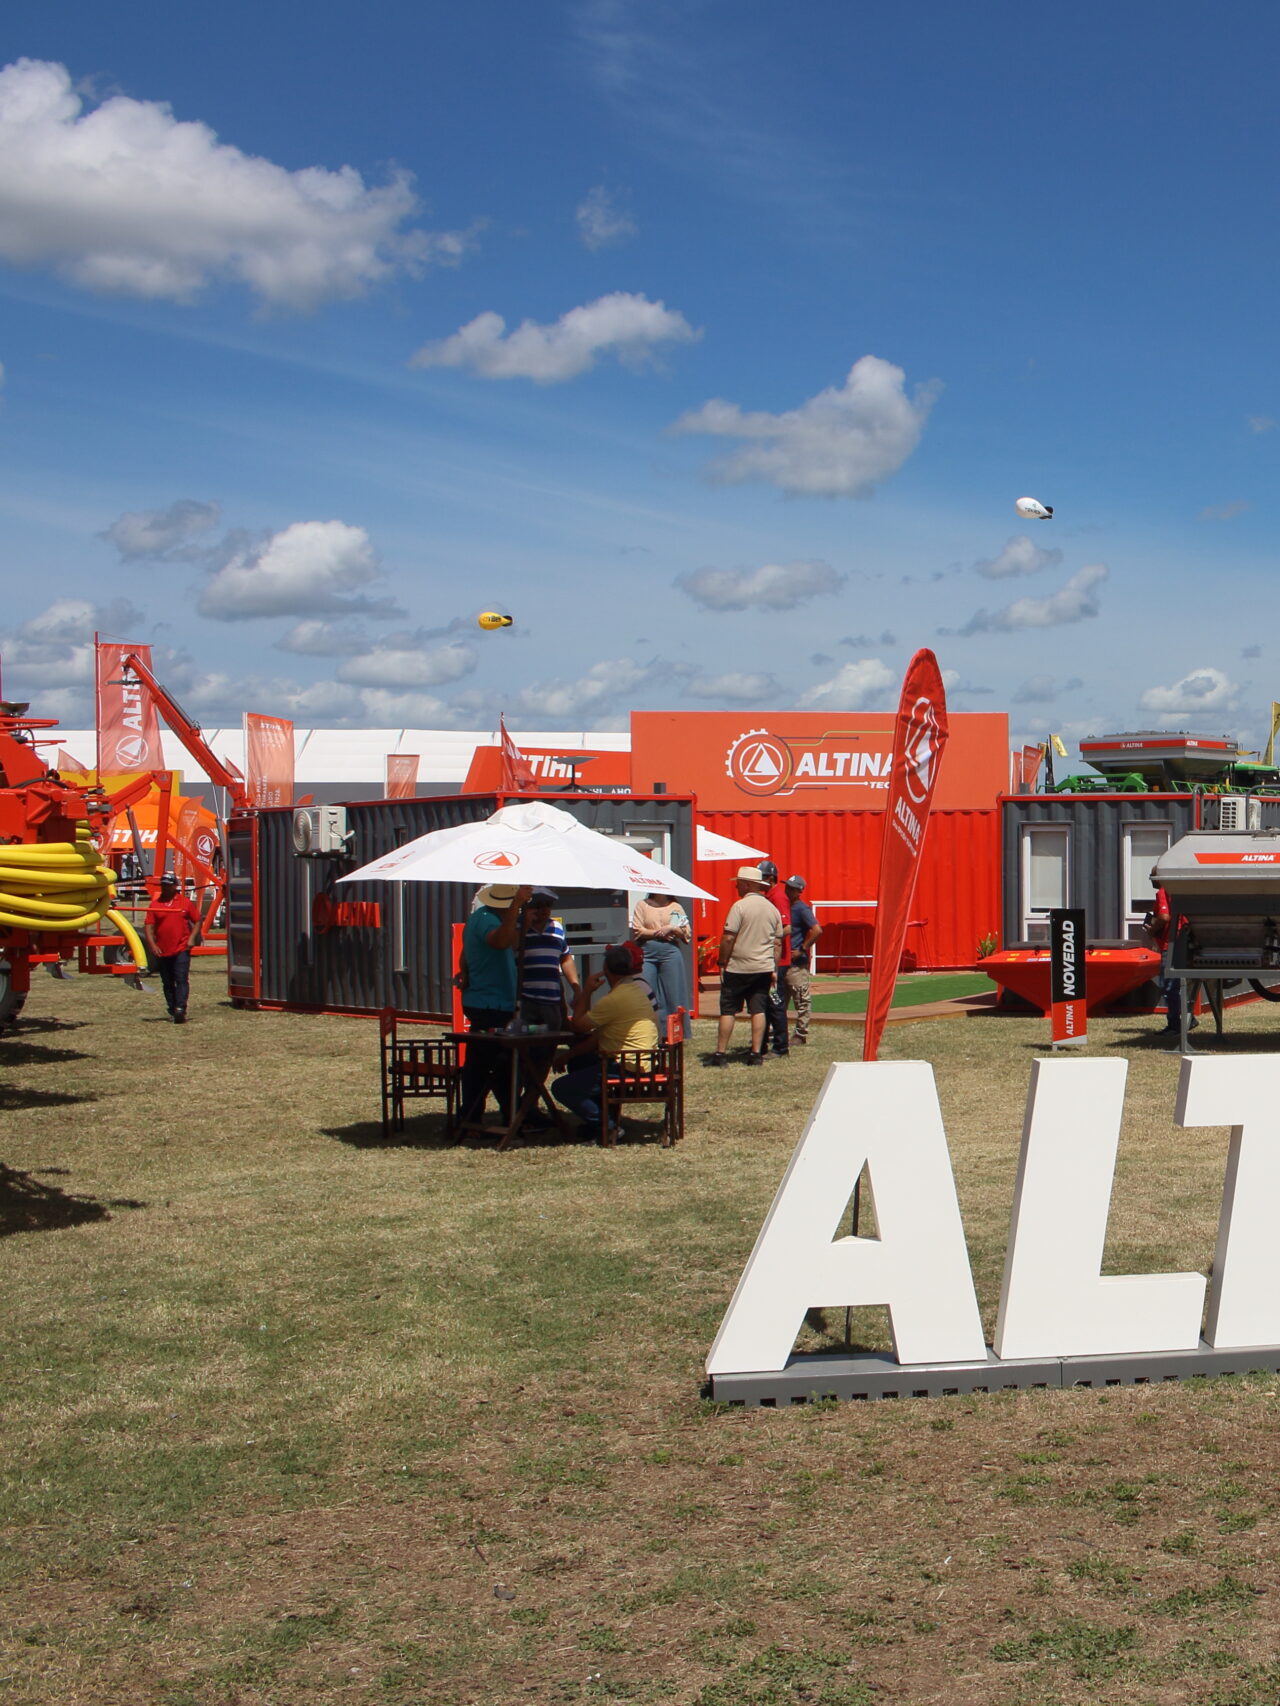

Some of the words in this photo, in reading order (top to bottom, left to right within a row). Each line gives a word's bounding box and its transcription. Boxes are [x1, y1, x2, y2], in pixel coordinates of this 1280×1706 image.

[894, 796, 920, 845] ALTINA
[1062, 920, 1075, 995] NOVEDAD
[1066, 1005, 1074, 1035] ALTINA
